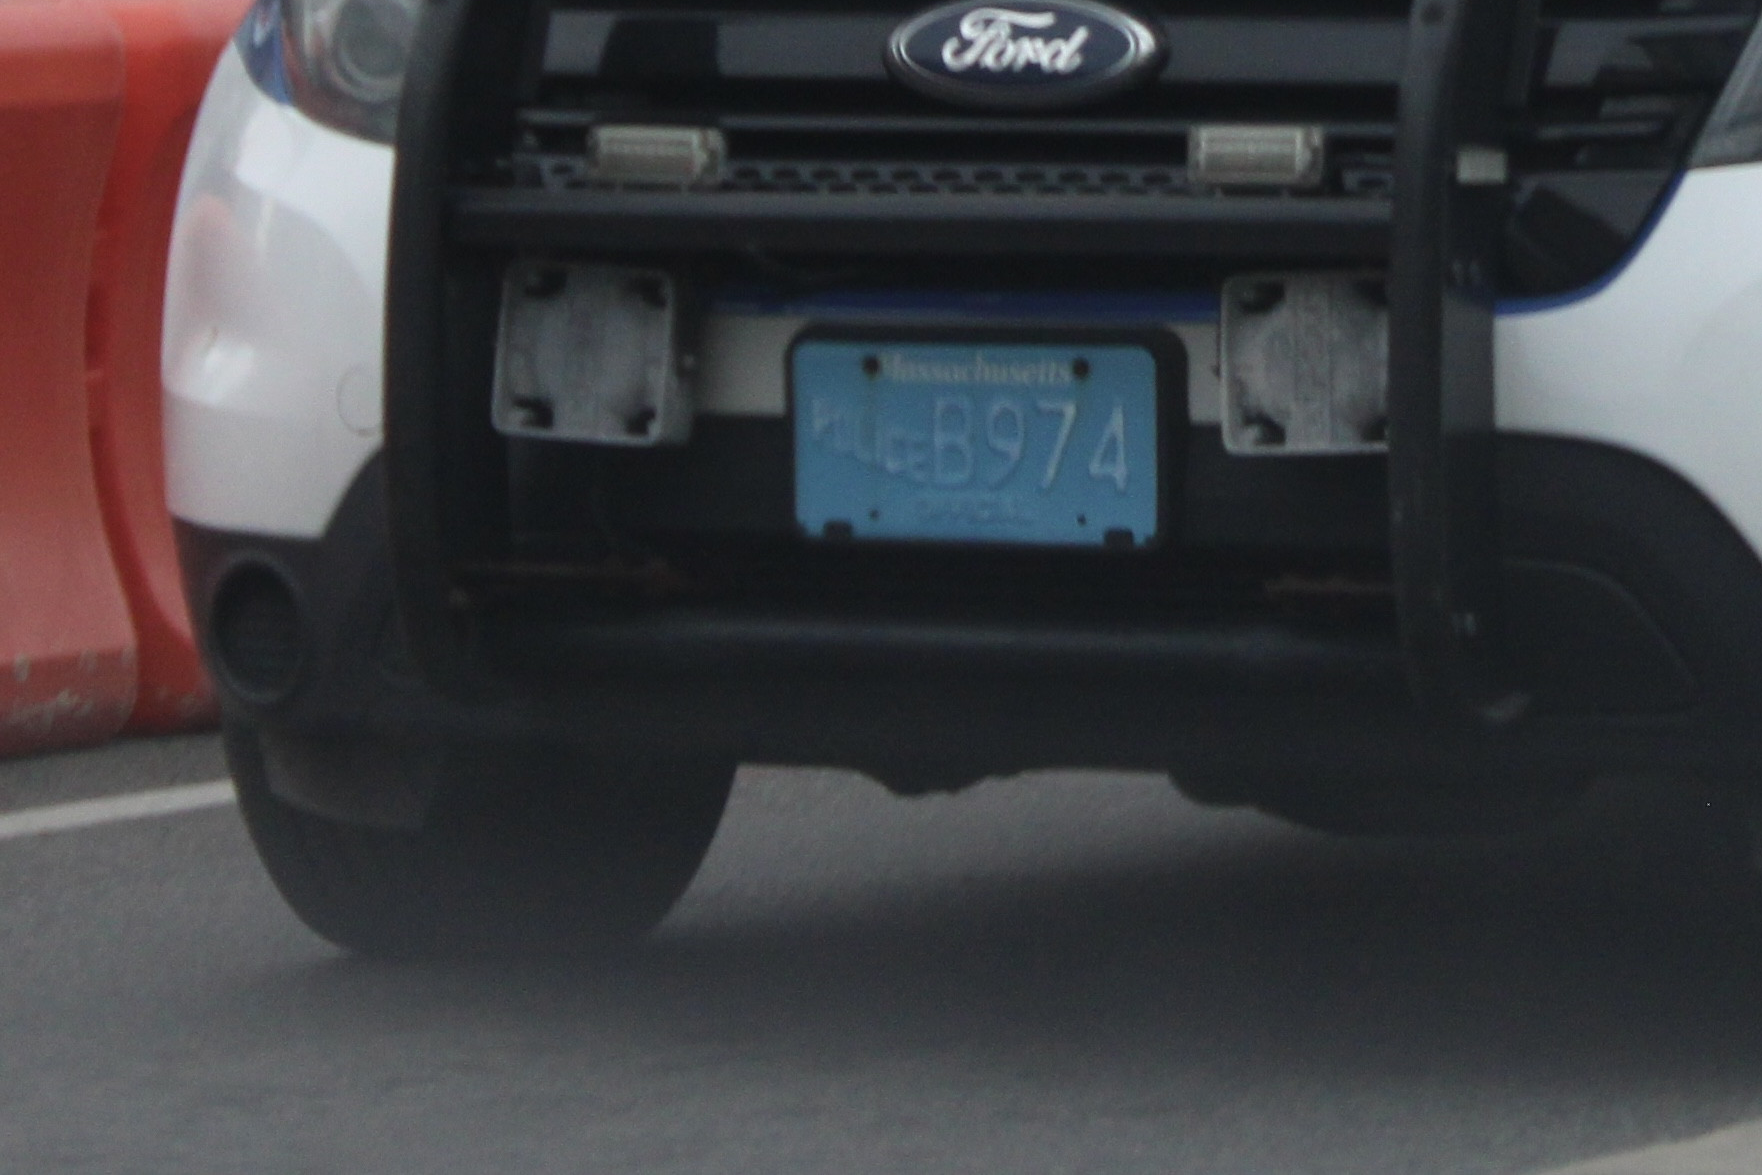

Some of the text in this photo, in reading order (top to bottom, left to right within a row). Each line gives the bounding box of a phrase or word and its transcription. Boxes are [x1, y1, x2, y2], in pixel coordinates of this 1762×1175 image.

[942, 7, 1089, 73] Ford
[880, 350, 1072, 385] Massachusetts
[933, 397, 1129, 494] B974
